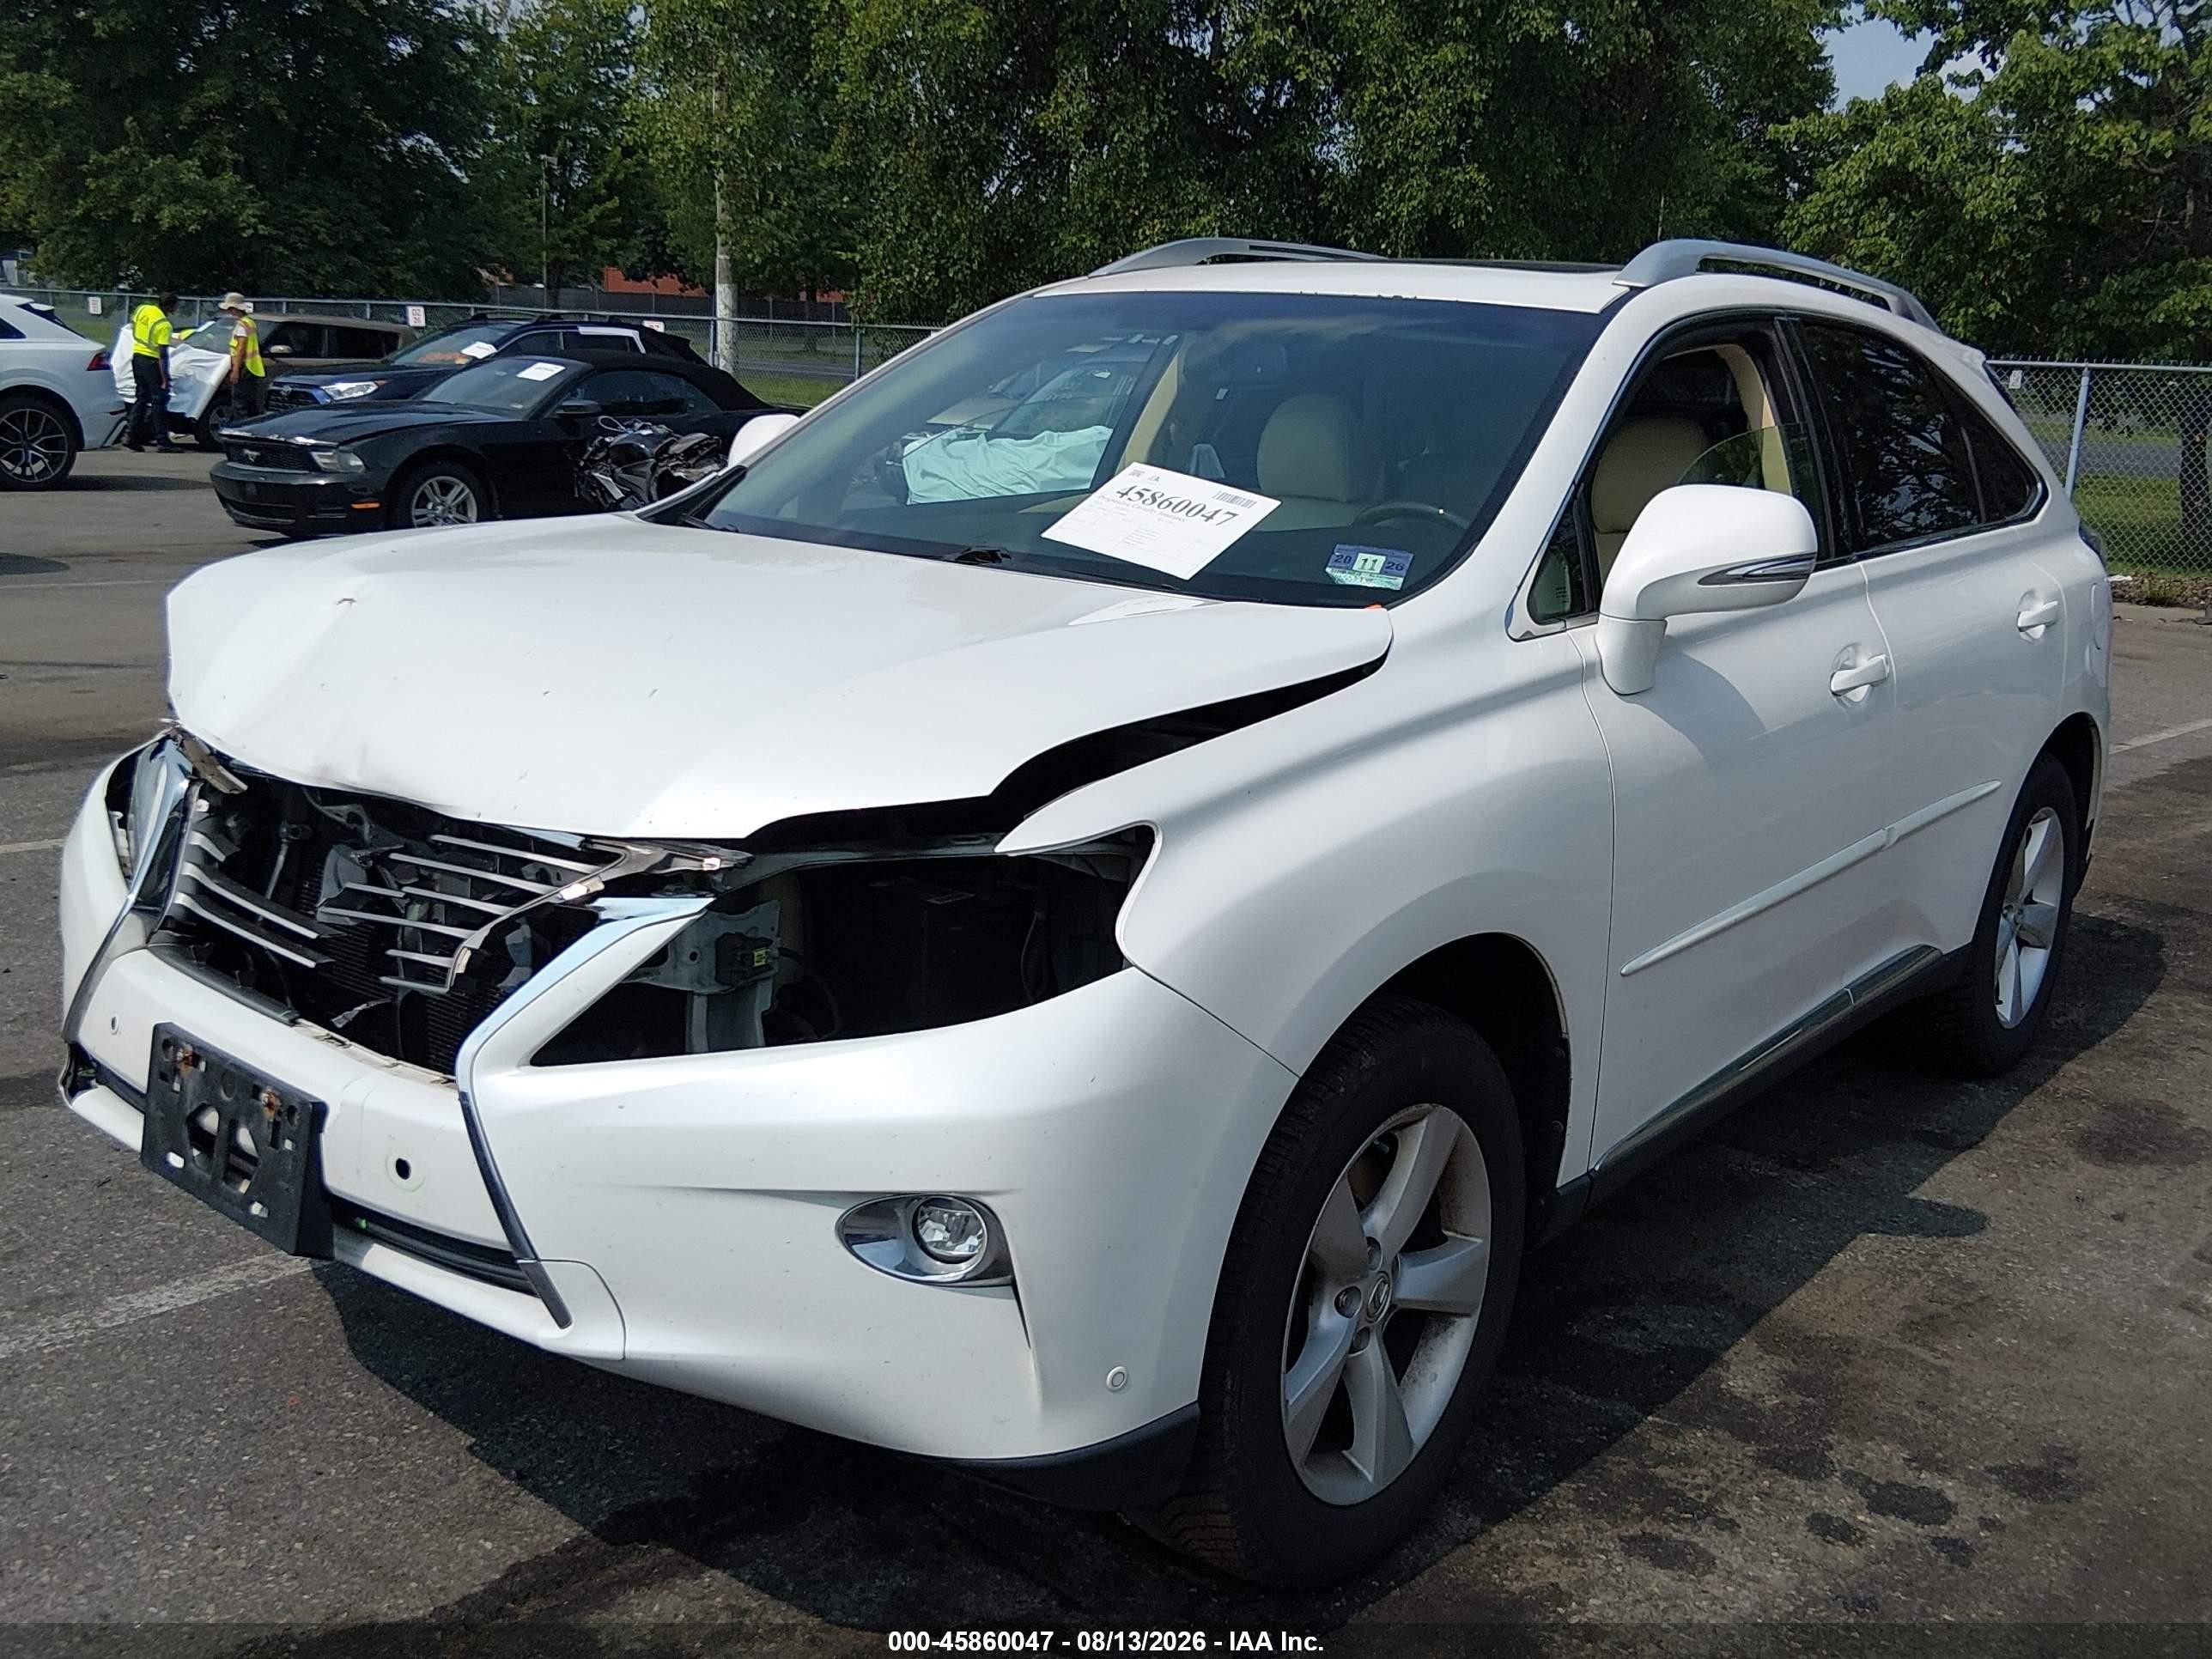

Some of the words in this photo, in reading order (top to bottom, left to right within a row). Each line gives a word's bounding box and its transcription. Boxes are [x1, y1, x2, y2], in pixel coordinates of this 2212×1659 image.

[1116, 485, 1239, 526] 45860047
[1334, 554, 1352, 564] 20
[1358, 557, 1378, 571] 11
